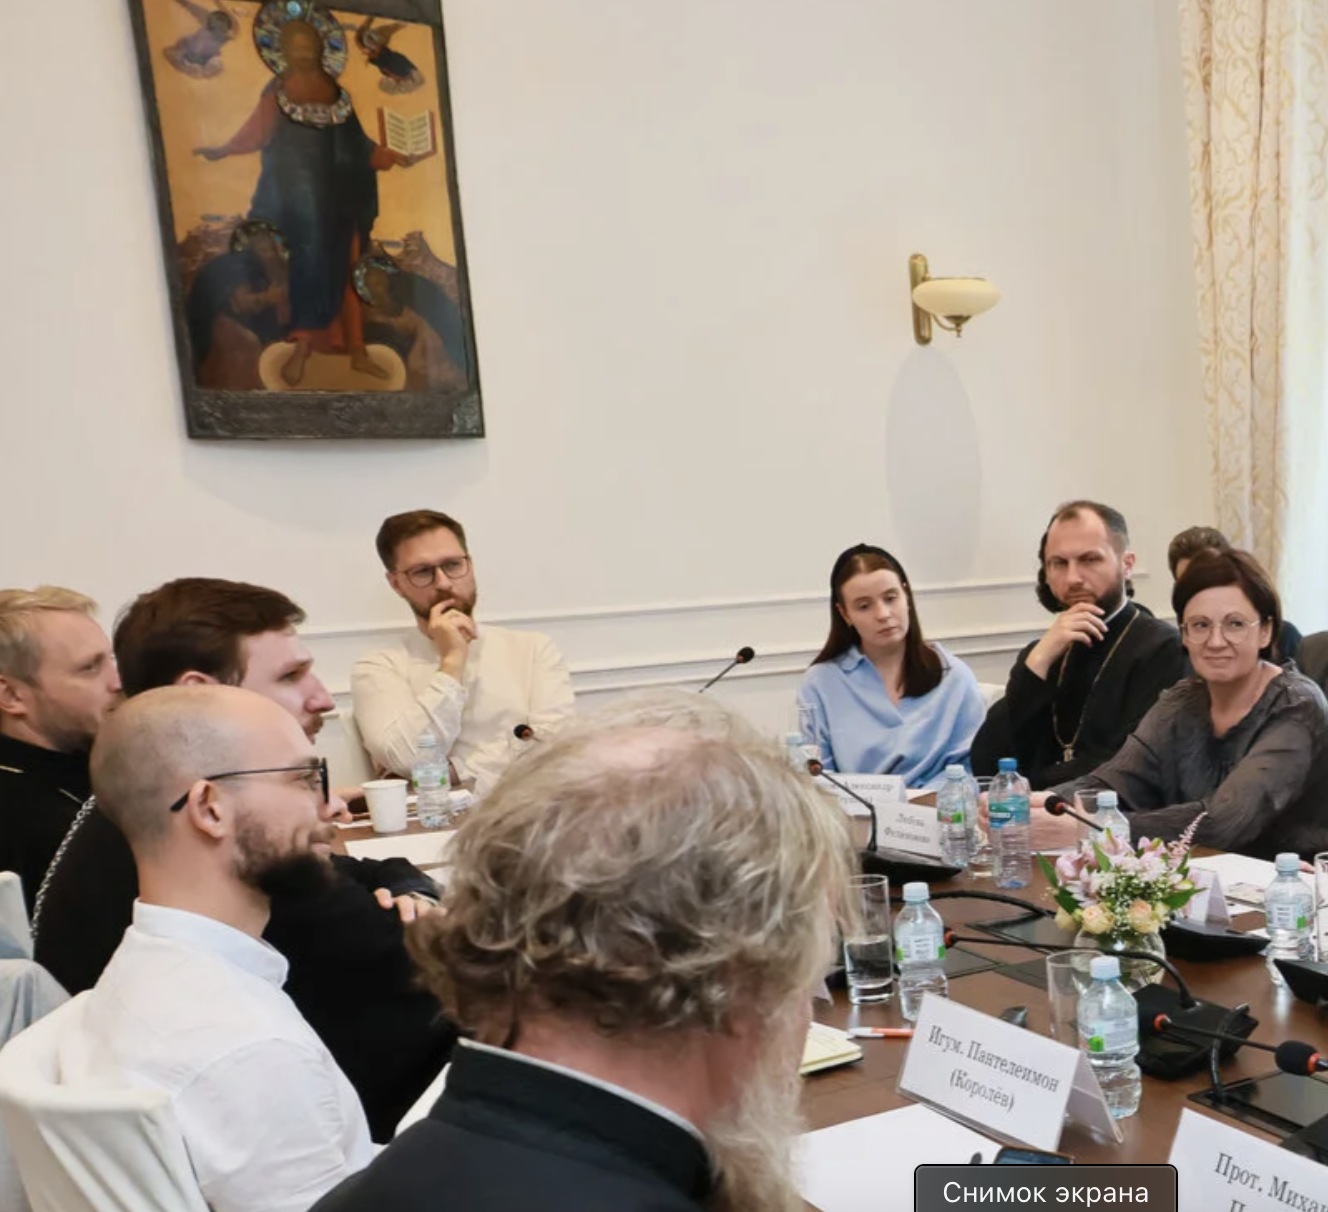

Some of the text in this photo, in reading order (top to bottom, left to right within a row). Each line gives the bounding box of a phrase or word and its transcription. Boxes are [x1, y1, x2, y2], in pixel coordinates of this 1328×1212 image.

[928, 1024, 1060, 1093] Игум. Пантелеимон
[949, 1067, 1015, 1113] (Королёв)
[1214, 1152, 1263, 1193] Прот.
